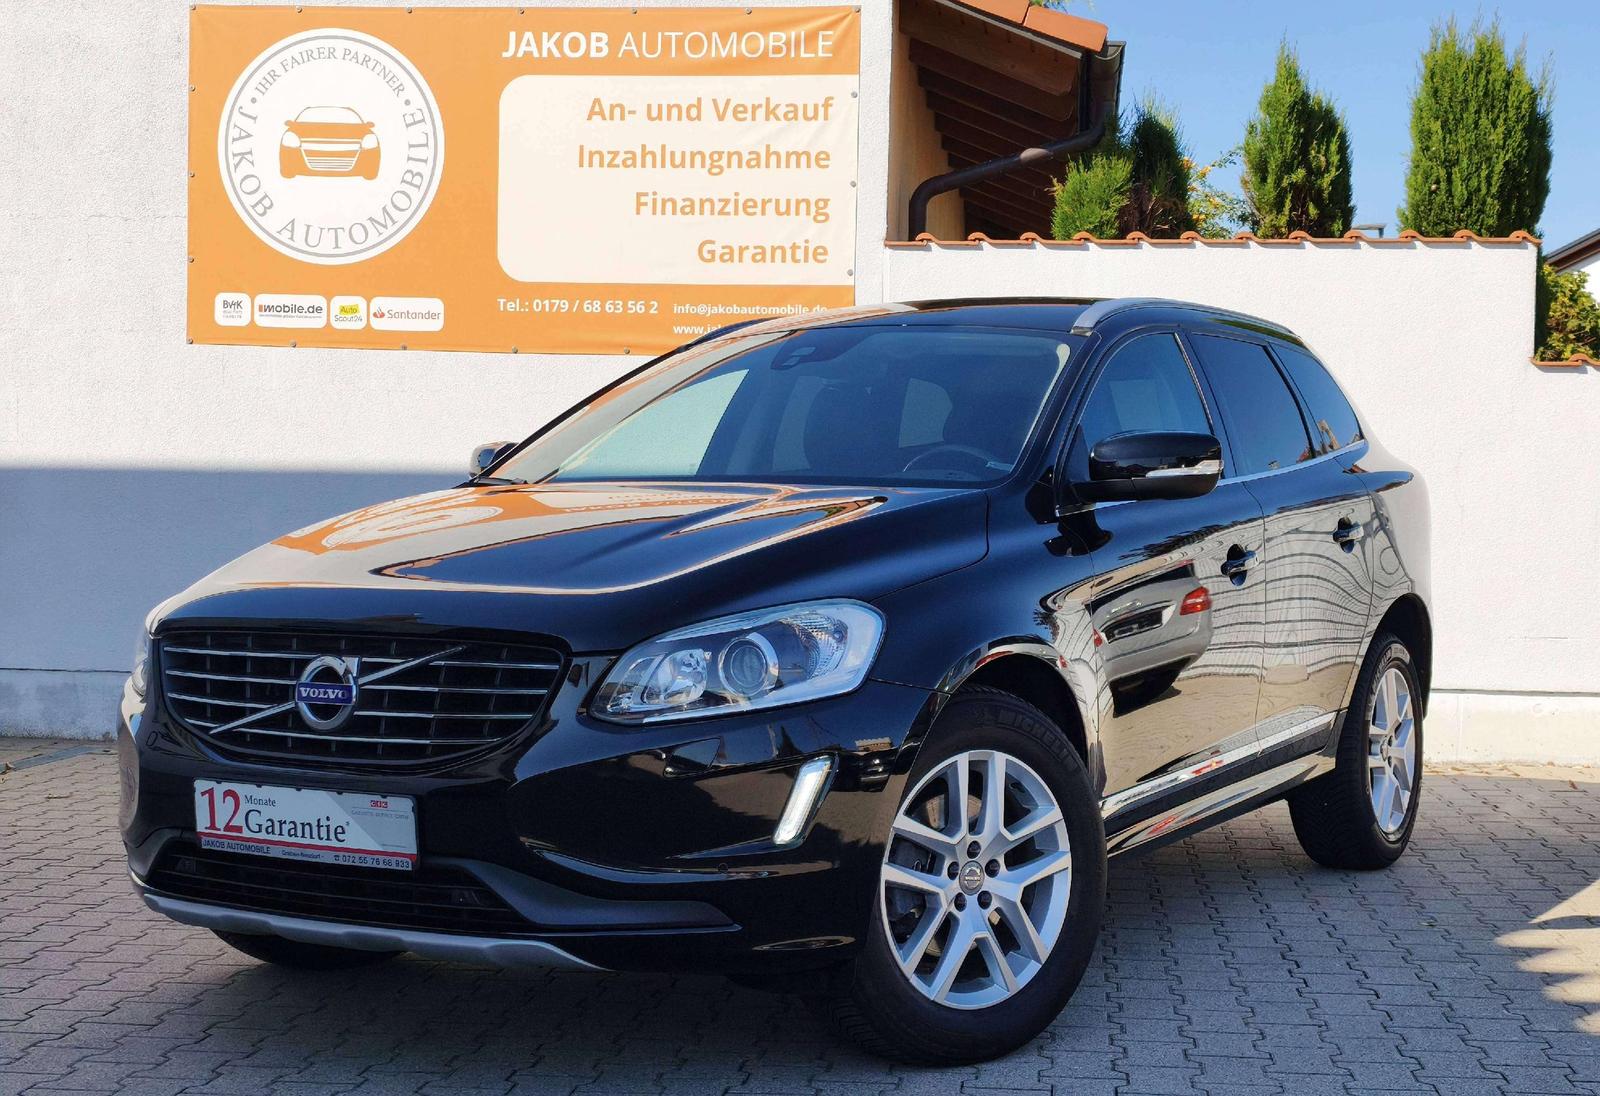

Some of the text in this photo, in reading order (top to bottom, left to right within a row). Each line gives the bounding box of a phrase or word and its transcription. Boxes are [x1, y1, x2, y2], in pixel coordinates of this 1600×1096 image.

[502, 31, 834, 59] JAKOB AUTOMOBILE
[254, 46, 406, 98] IHR FAIRER PARTNER
[586, 96, 834, 122] An- und Verkauf
[578, 144, 831, 176] Inzahlungnahme
[231, 106, 430, 250] JAKOB AUTOMOBILE
[635, 191, 831, 224] Finanzierung
[697, 239, 829, 264] Garantie
[263, 304, 323, 314] mobile.de
[387, 309, 441, 320] Santander
[497, 298, 658, 314] Tel.: 0179 / 68 63 56 2
[299, 687, 348, 699] VOLVO
[200, 787, 243, 833] 12
[244, 795, 276, 807] Monate
[202, 839, 271, 854] JAKOB AUTOMOBILE
[342, 855, 356, 864] 072
[358, 856, 369, 864] 55
[383, 858, 393, 867] 68
